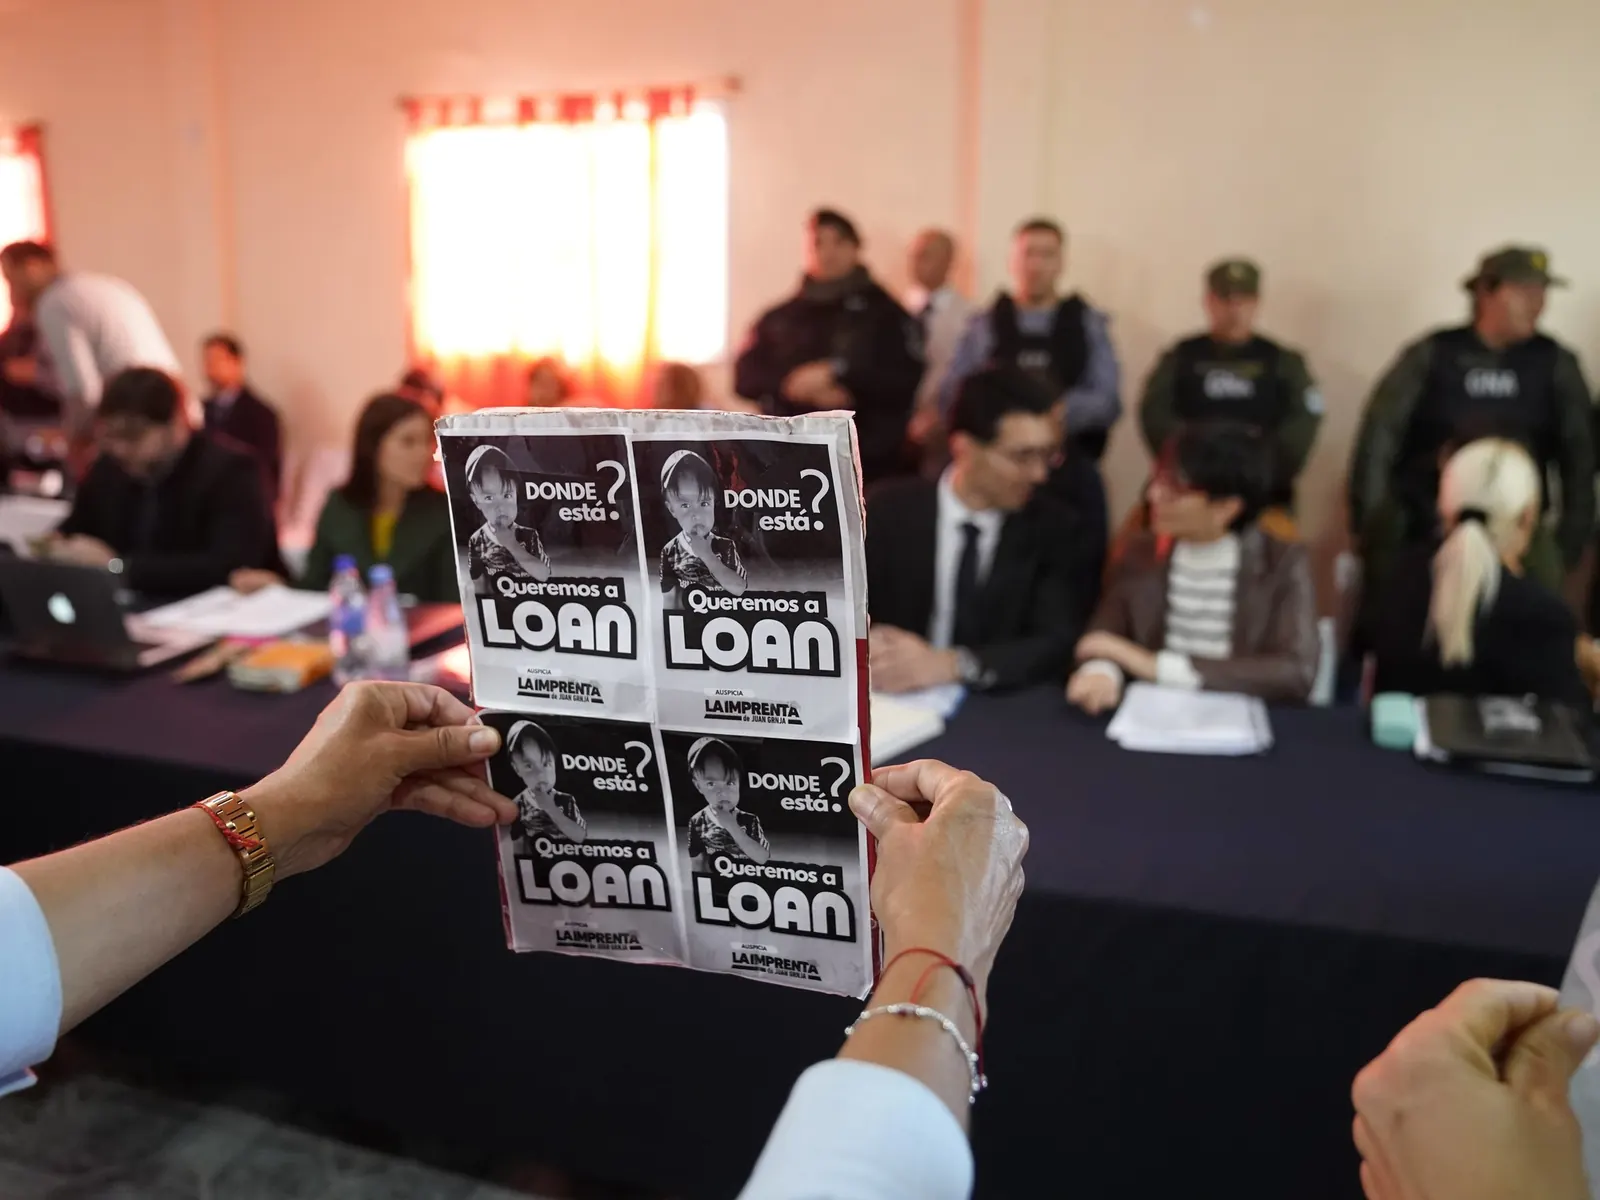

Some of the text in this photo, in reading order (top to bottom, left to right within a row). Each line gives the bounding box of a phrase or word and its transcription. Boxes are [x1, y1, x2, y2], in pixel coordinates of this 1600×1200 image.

[525, 482, 597, 501] DONDE
[723, 489, 801, 509] DONDE
[496, 576, 618, 598] Queremos a
[688, 589, 819, 614] Queremos a
[481, 598, 631, 654] LOAN
[668, 614, 835, 672] LOAN
[752, 715, 766, 723] JUAN
[562, 754, 628, 774] DONDE
[748, 772, 820, 793] DONDE
[535, 837, 650, 859] Queremos a
[714, 855, 836, 886] Queremos a
[519, 859, 667, 907] LOAN
[697, 876, 850, 937] LOAN
